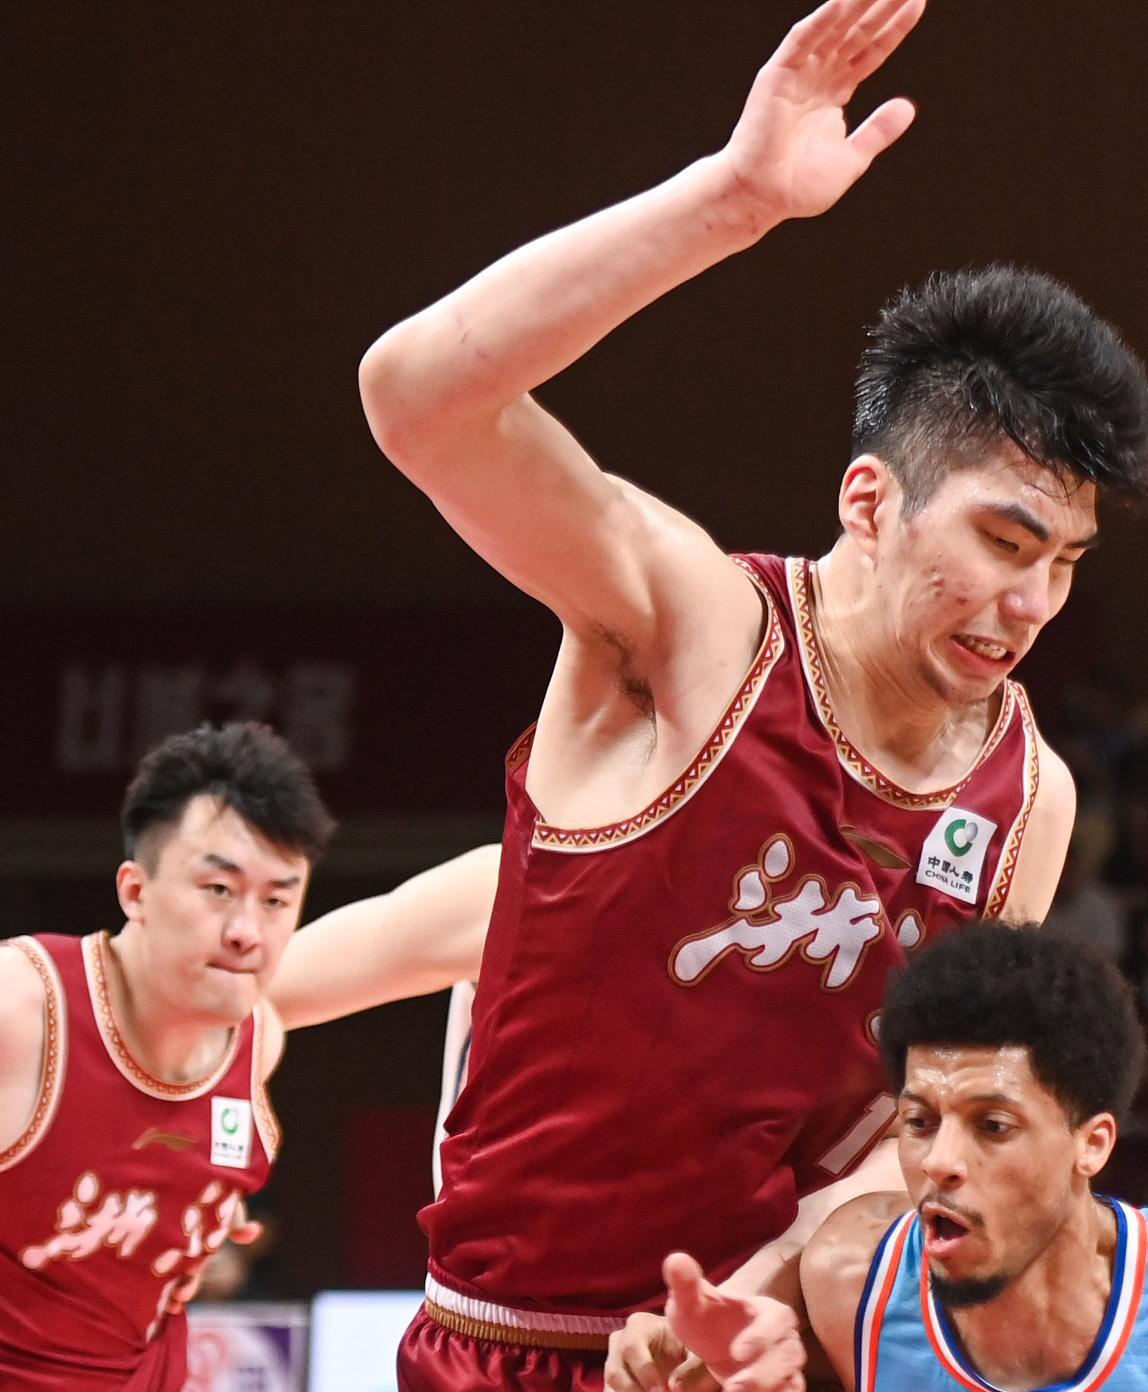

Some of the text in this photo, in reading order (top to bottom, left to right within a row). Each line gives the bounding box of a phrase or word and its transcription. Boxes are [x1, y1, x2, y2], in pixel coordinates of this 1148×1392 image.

[924, 870, 972, 894] CHINA LIFE
[927, 856, 974, 884] 中国人寿
